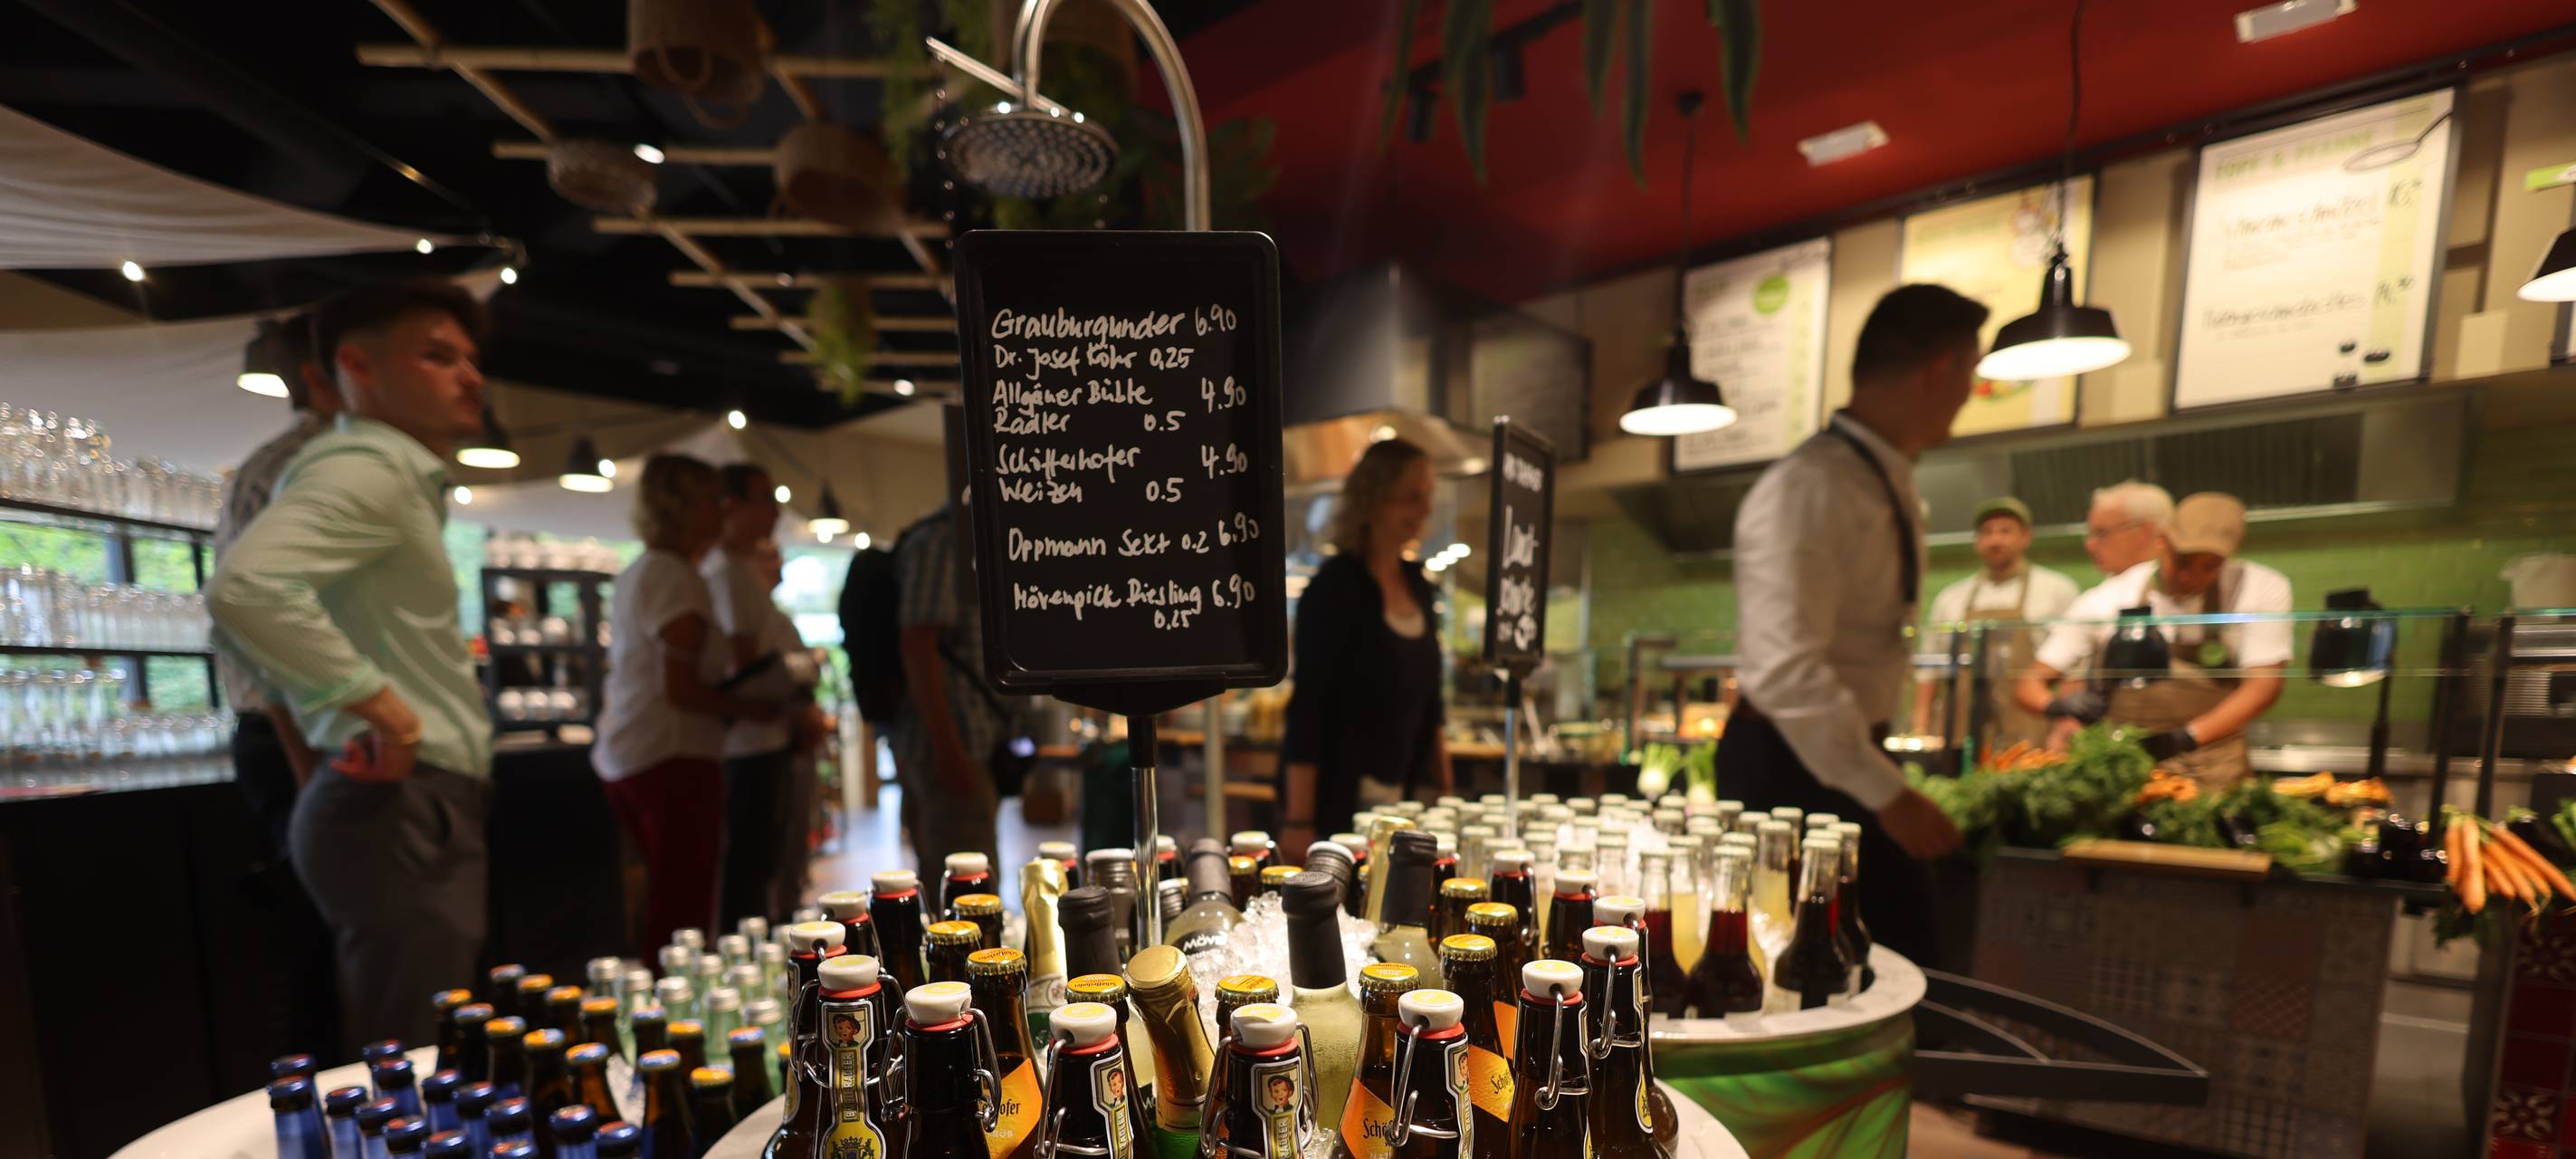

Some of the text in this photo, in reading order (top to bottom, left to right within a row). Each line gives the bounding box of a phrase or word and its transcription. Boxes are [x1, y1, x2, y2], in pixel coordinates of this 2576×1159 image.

[992, 303, 1237, 344] Grauburgunder 6.90
[993, 344, 1023, 369] Dr.
[1026, 346, 1081, 381] Josef
[1149, 346, 1195, 370] 0,25
[992, 378, 1084, 417] Allgäuer
[1200, 376, 1247, 413] 4.90
[993, 407, 1187, 436] Radler 0.5
[1200, 442, 1249, 480] 4.90
[997, 476, 1185, 504] Weizen 0.5
[1008, 512, 1260, 563] Oppmann Sekt 0.2 6.90
[1014, 573, 1256, 621] Mövenpick Riesling 6.90
[1154, 610, 1197, 631] 0.25
[843, 1052, 854, 1087] RADLER
